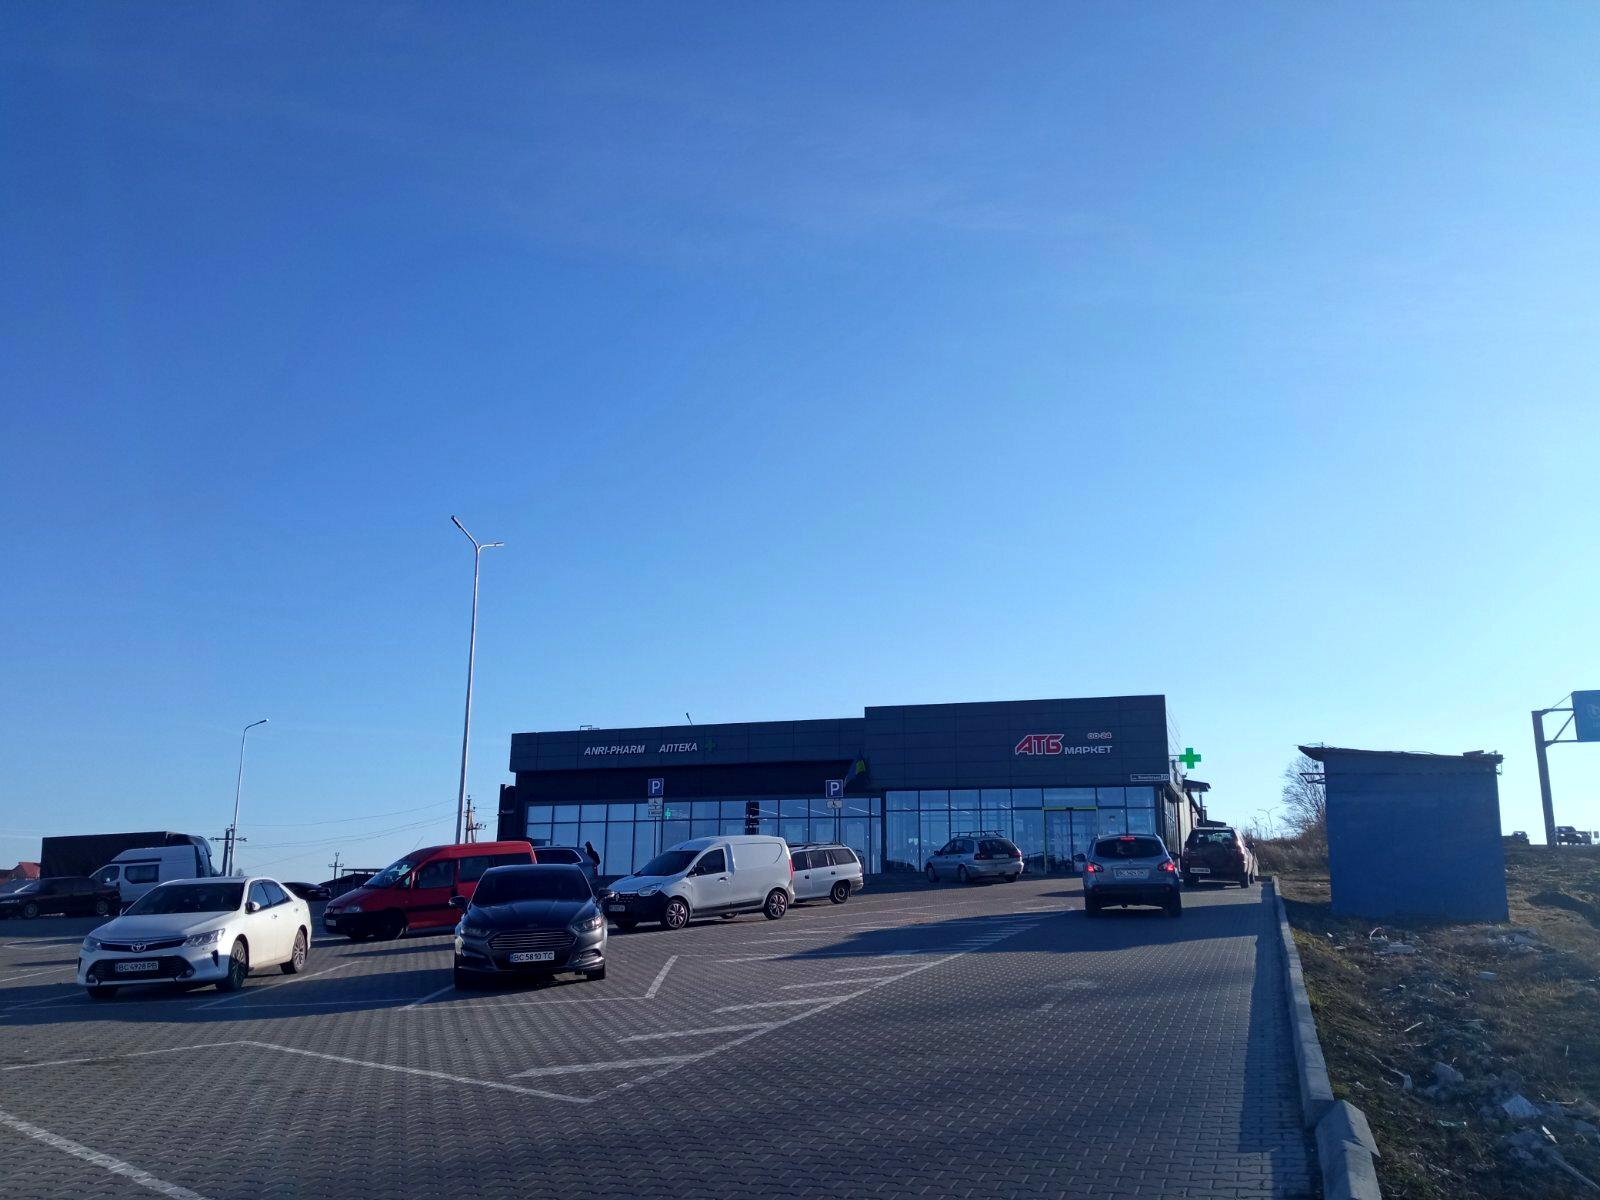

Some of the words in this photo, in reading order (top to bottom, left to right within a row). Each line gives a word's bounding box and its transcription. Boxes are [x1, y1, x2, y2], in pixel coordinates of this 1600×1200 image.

[584, 745, 645, 755] ANRI-PHARM
[659, 743, 697, 752] АПТЕКА
[1015, 734, 1064, 755] АТБ
[1064, 746, 1112, 754] МАРКЕТ
[652, 781, 660, 793] P
[831, 782, 839, 795] P
